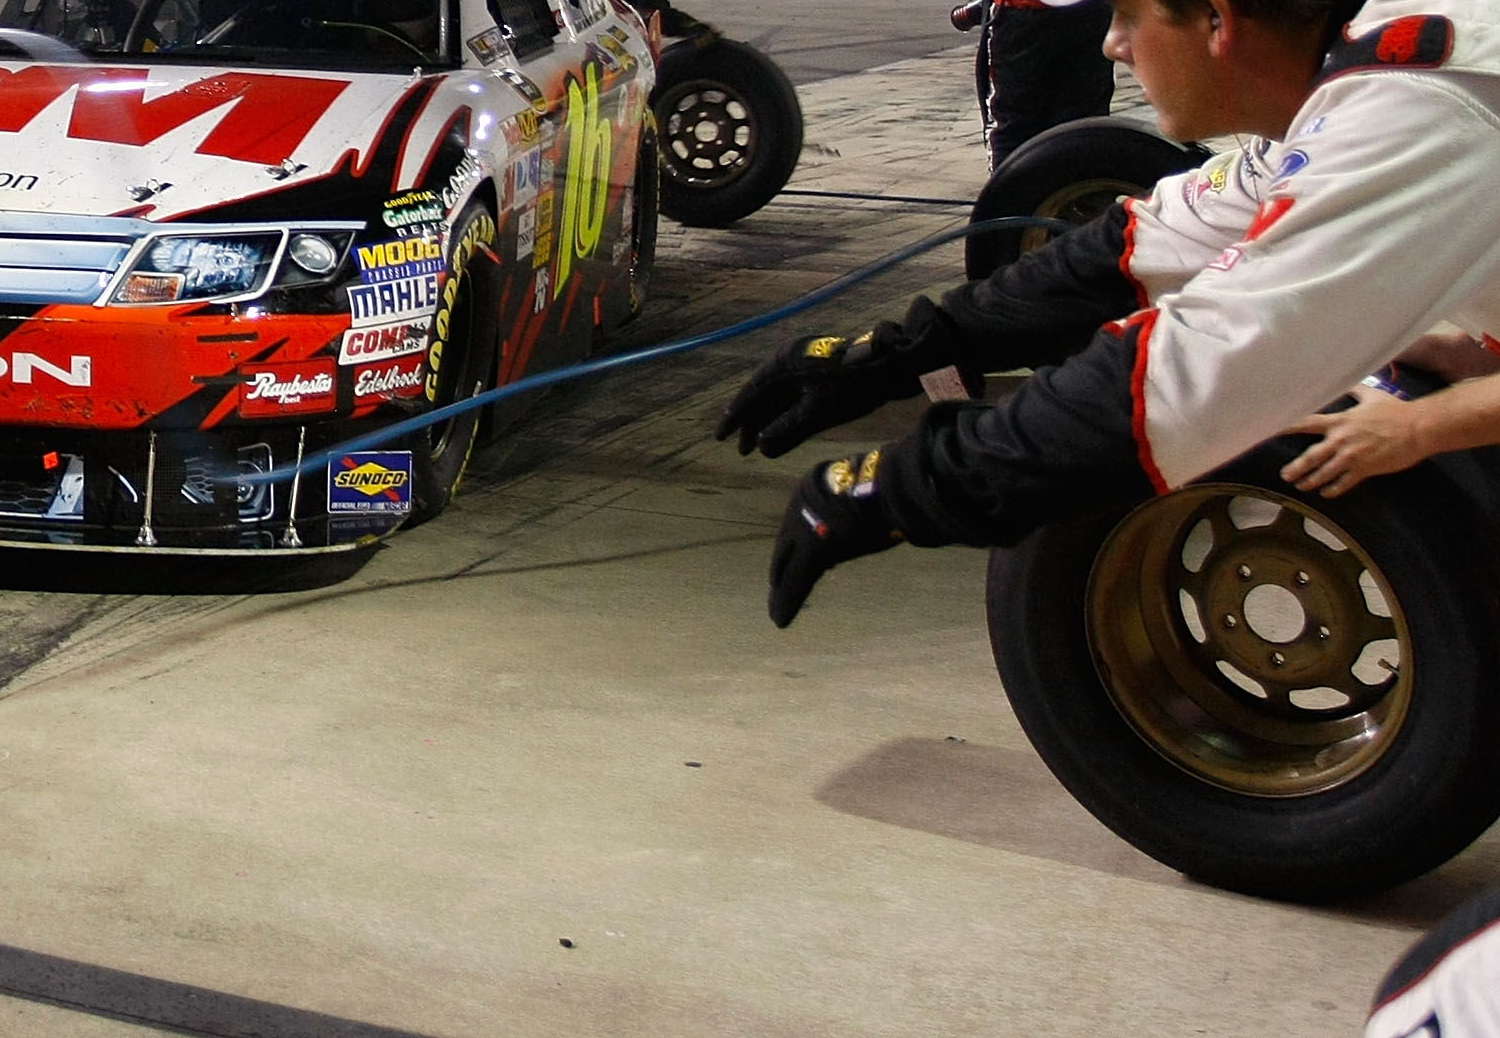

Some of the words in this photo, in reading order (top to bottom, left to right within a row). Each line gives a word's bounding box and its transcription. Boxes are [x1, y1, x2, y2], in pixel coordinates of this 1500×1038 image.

[384, 189, 438, 209] GOODYEAR
[357, 235, 442, 271] MOOG
[368, 265, 412, 283] CHASSIS
[352, 276, 438, 319] MAHLE
[246, 372, 332, 400] Raybestos
[355, 363, 423, 397] Edelbrock
[337, 472, 406, 485] SUNOCO
